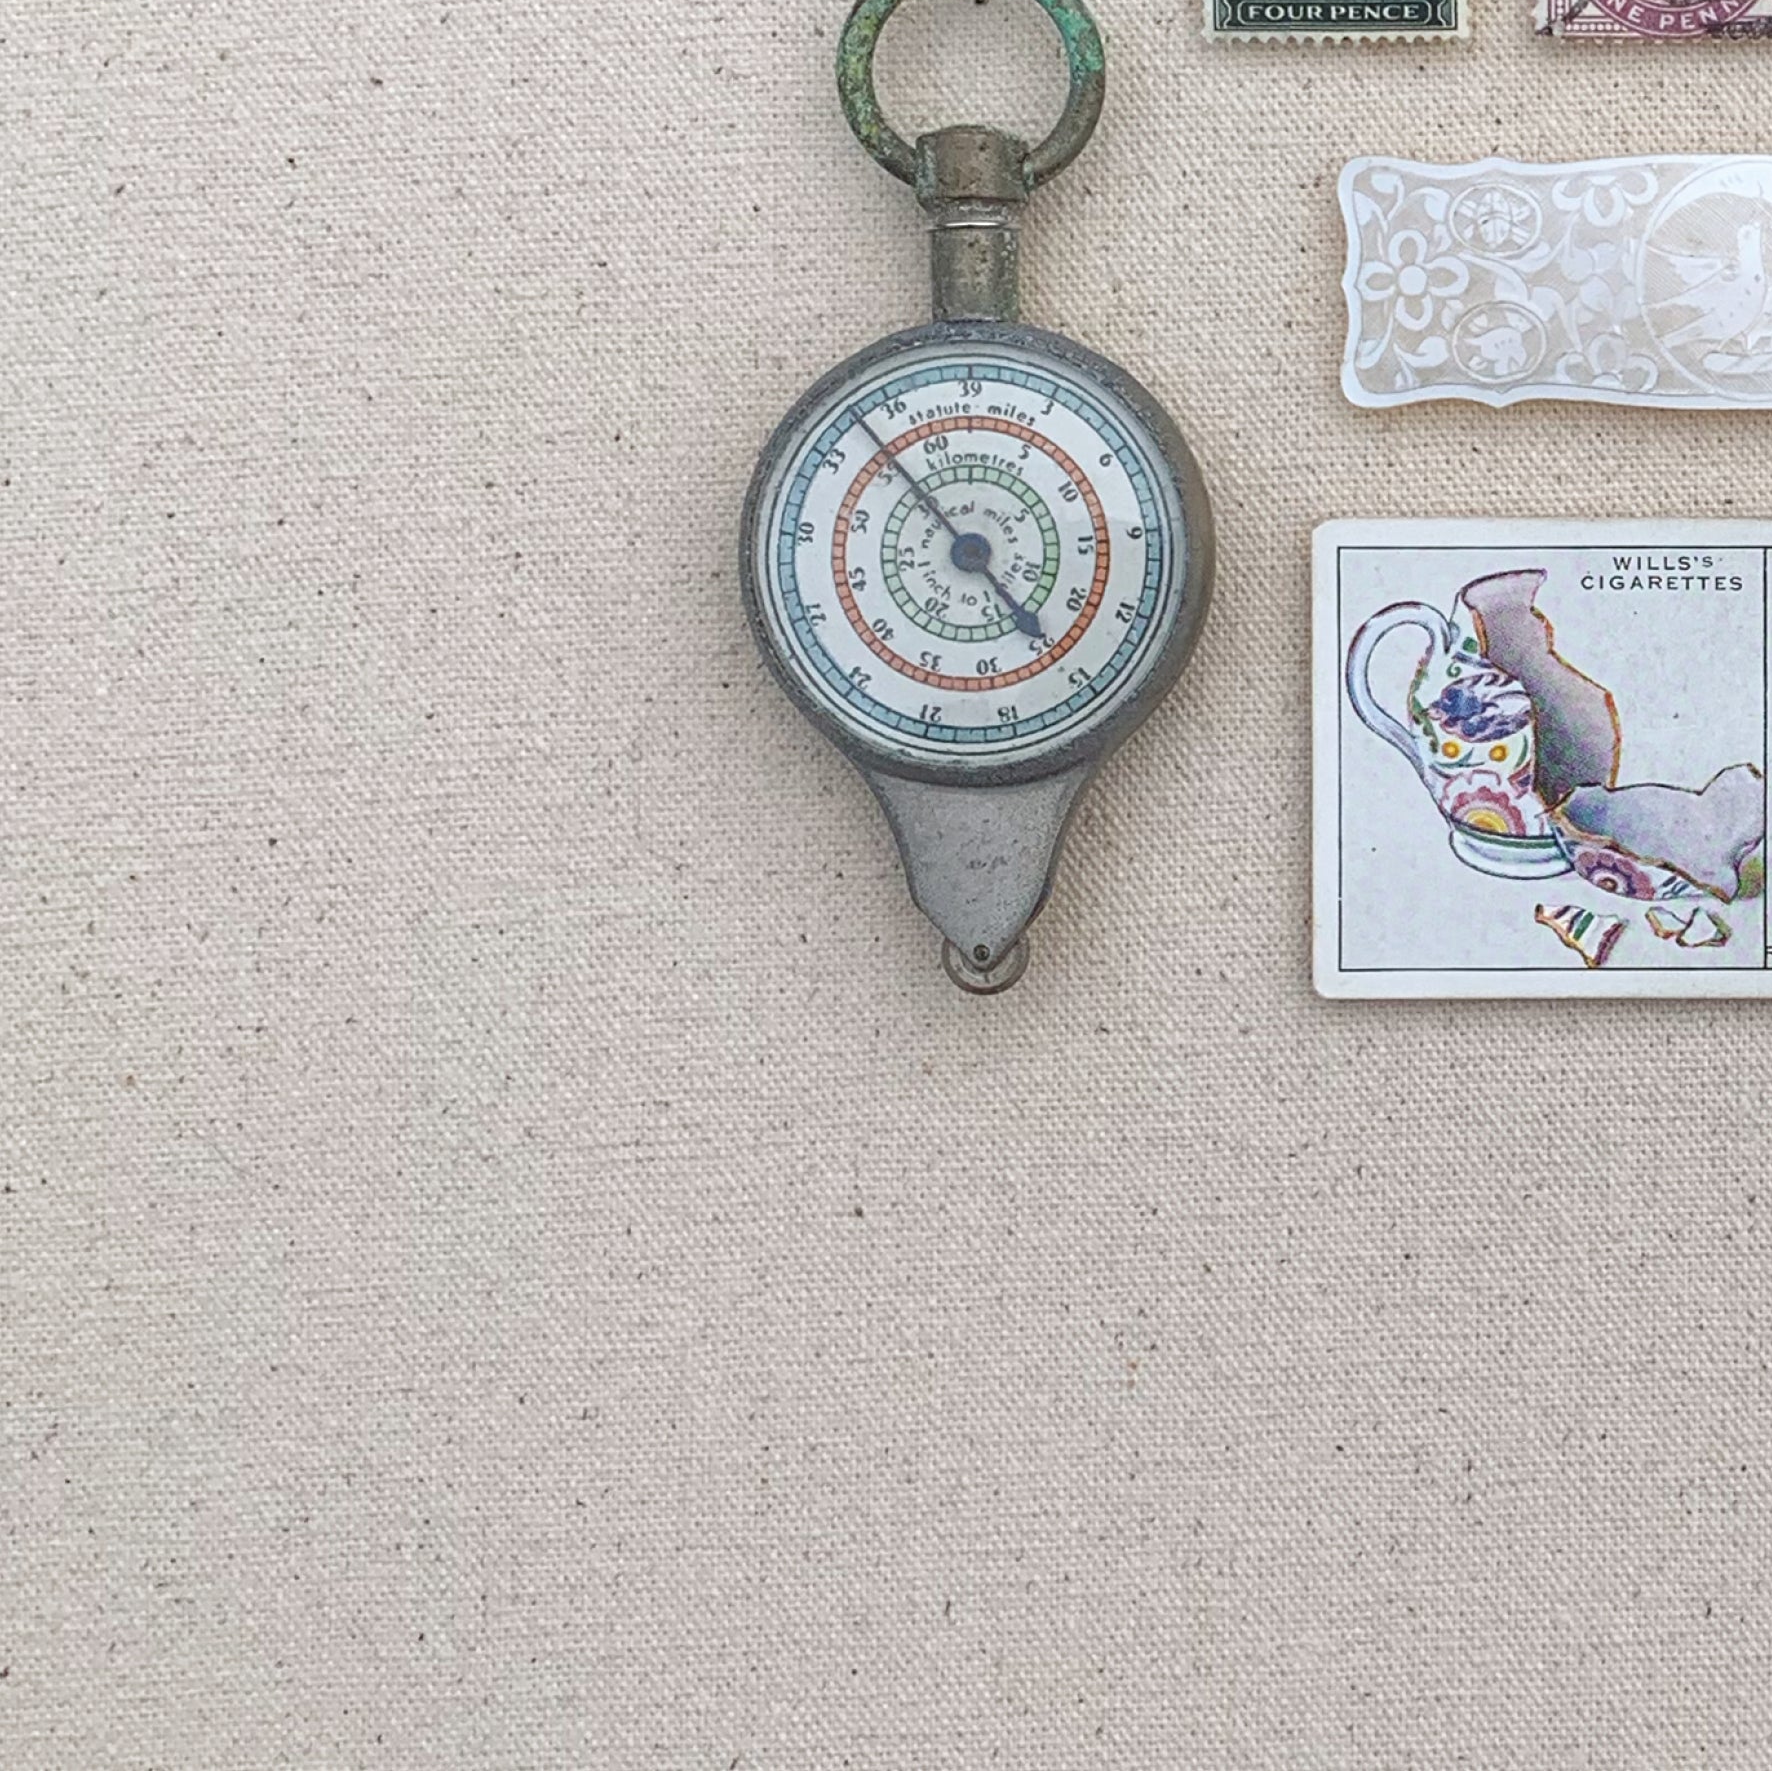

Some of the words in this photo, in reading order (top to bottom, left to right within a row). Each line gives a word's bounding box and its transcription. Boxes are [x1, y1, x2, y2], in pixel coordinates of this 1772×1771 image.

[1249, 5, 1323, 20] FOUR
[1331, 4, 1419, 20] PENCE
[959, 382, 982, 398] 39
[880, 399, 906, 420] 36
[909, 402, 970, 425] statute
[988, 402, 1036, 426] miles
[923, 435, 948, 454] 60
[1018, 445, 1032, 460] 5
[822, 449, 846, 474] 33
[926, 452, 1023, 477] kilometres
[1058, 480, 1078, 502] 10
[852, 509, 869, 533] 50
[922, 500, 975, 549] nauical
[983, 508, 1019, 544] miles
[900, 547, 914, 572] 25
[923, 570, 950, 601] inch
[962, 593, 977, 606] to
[1581, 575, 1744, 592] CIGARETTES
[976, 656, 1001, 675] 30
